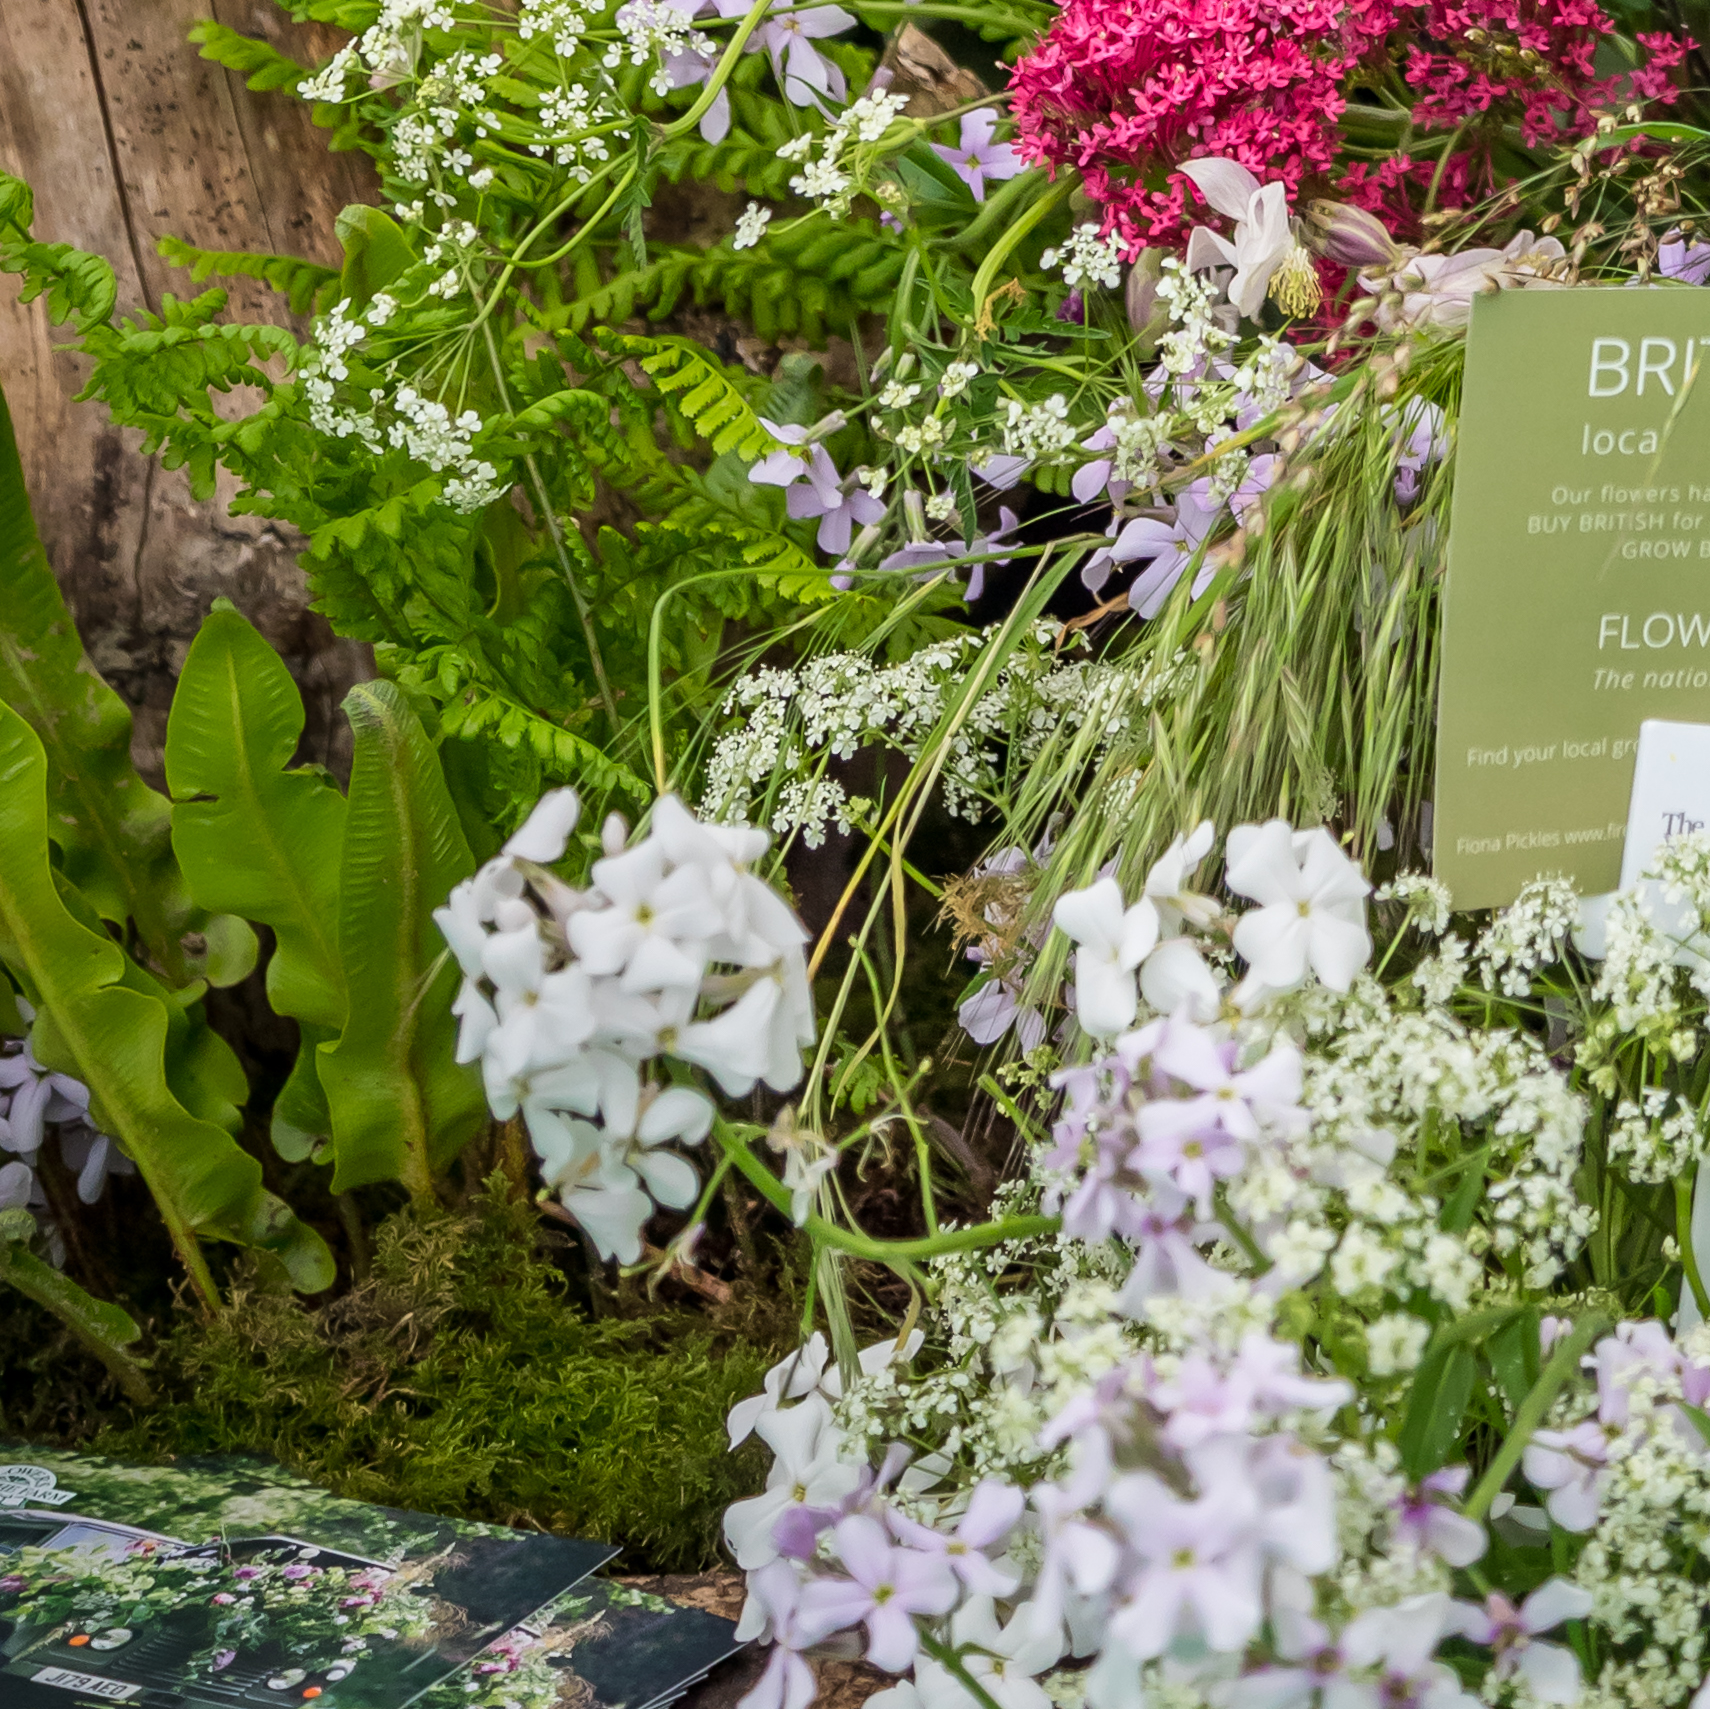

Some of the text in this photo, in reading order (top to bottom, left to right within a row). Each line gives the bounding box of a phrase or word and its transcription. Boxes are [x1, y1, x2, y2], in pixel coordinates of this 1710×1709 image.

[1582, 422, 1662, 456] loca
[1551, 486, 1591, 505] Our
[1601, 485, 1680, 504] flowers
[1527, 514, 1572, 534] BUY
[1579, 511, 1664, 533] BRITISH
[1673, 511, 1703, 531] for
[1622, 540, 1691, 559] GROW
[1594, 668, 1635, 691] The
[1467, 745, 1508, 767] Find
[1513, 745, 1556, 769] your
[1563, 737, 1607, 759] local
[1662, 812, 1705, 837] The
[1506, 830, 1561, 850] Pickles
